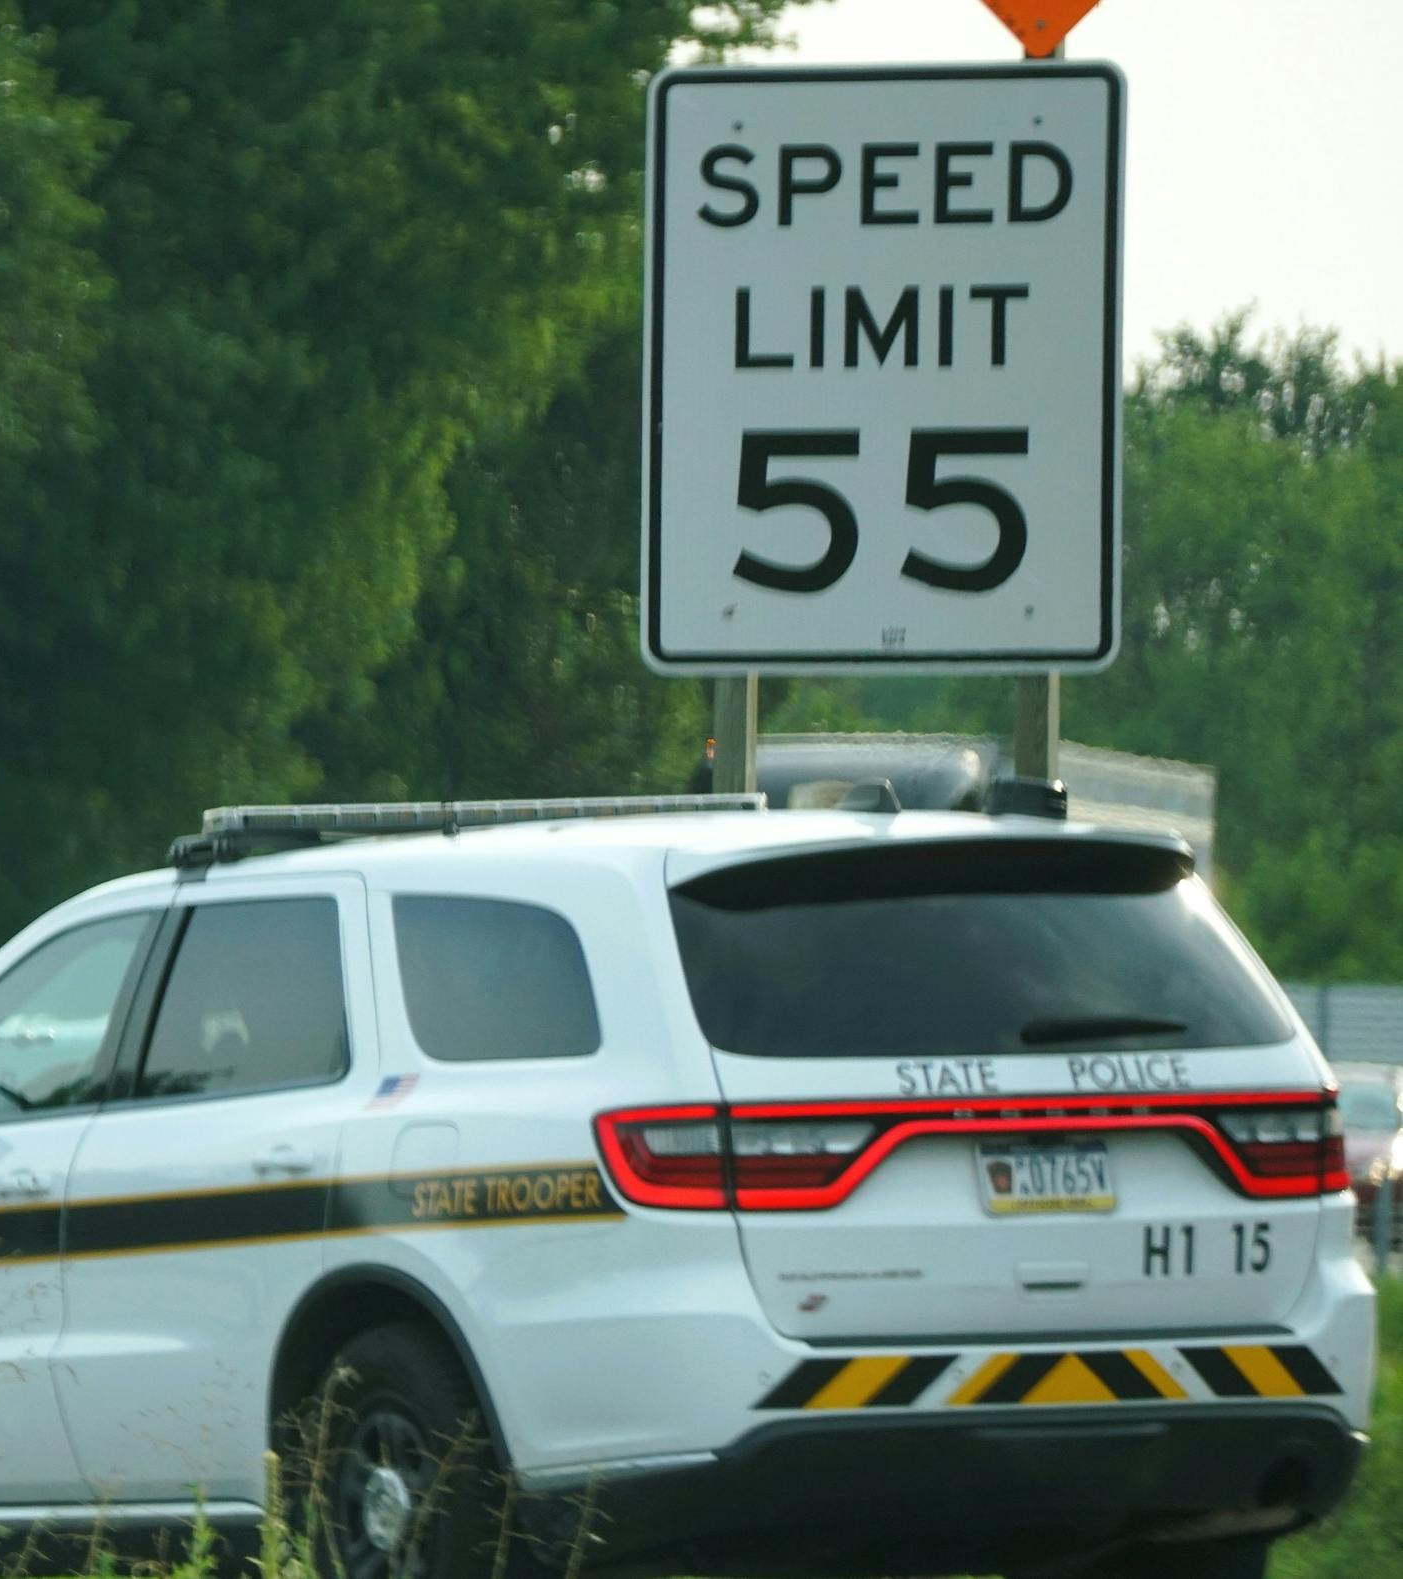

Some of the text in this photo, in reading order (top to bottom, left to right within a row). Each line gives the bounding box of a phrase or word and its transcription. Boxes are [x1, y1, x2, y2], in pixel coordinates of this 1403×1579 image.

[697, 140, 1073, 228] SPEED
[735, 284, 1029, 369] LIMIT
[732, 427, 1029, 594] 55
[896, 1053, 1191, 1096] STATE POLICE
[412, 1171, 601, 1218] STATE TROOPER
[1143, 1222, 1271, 1276] H1 15
